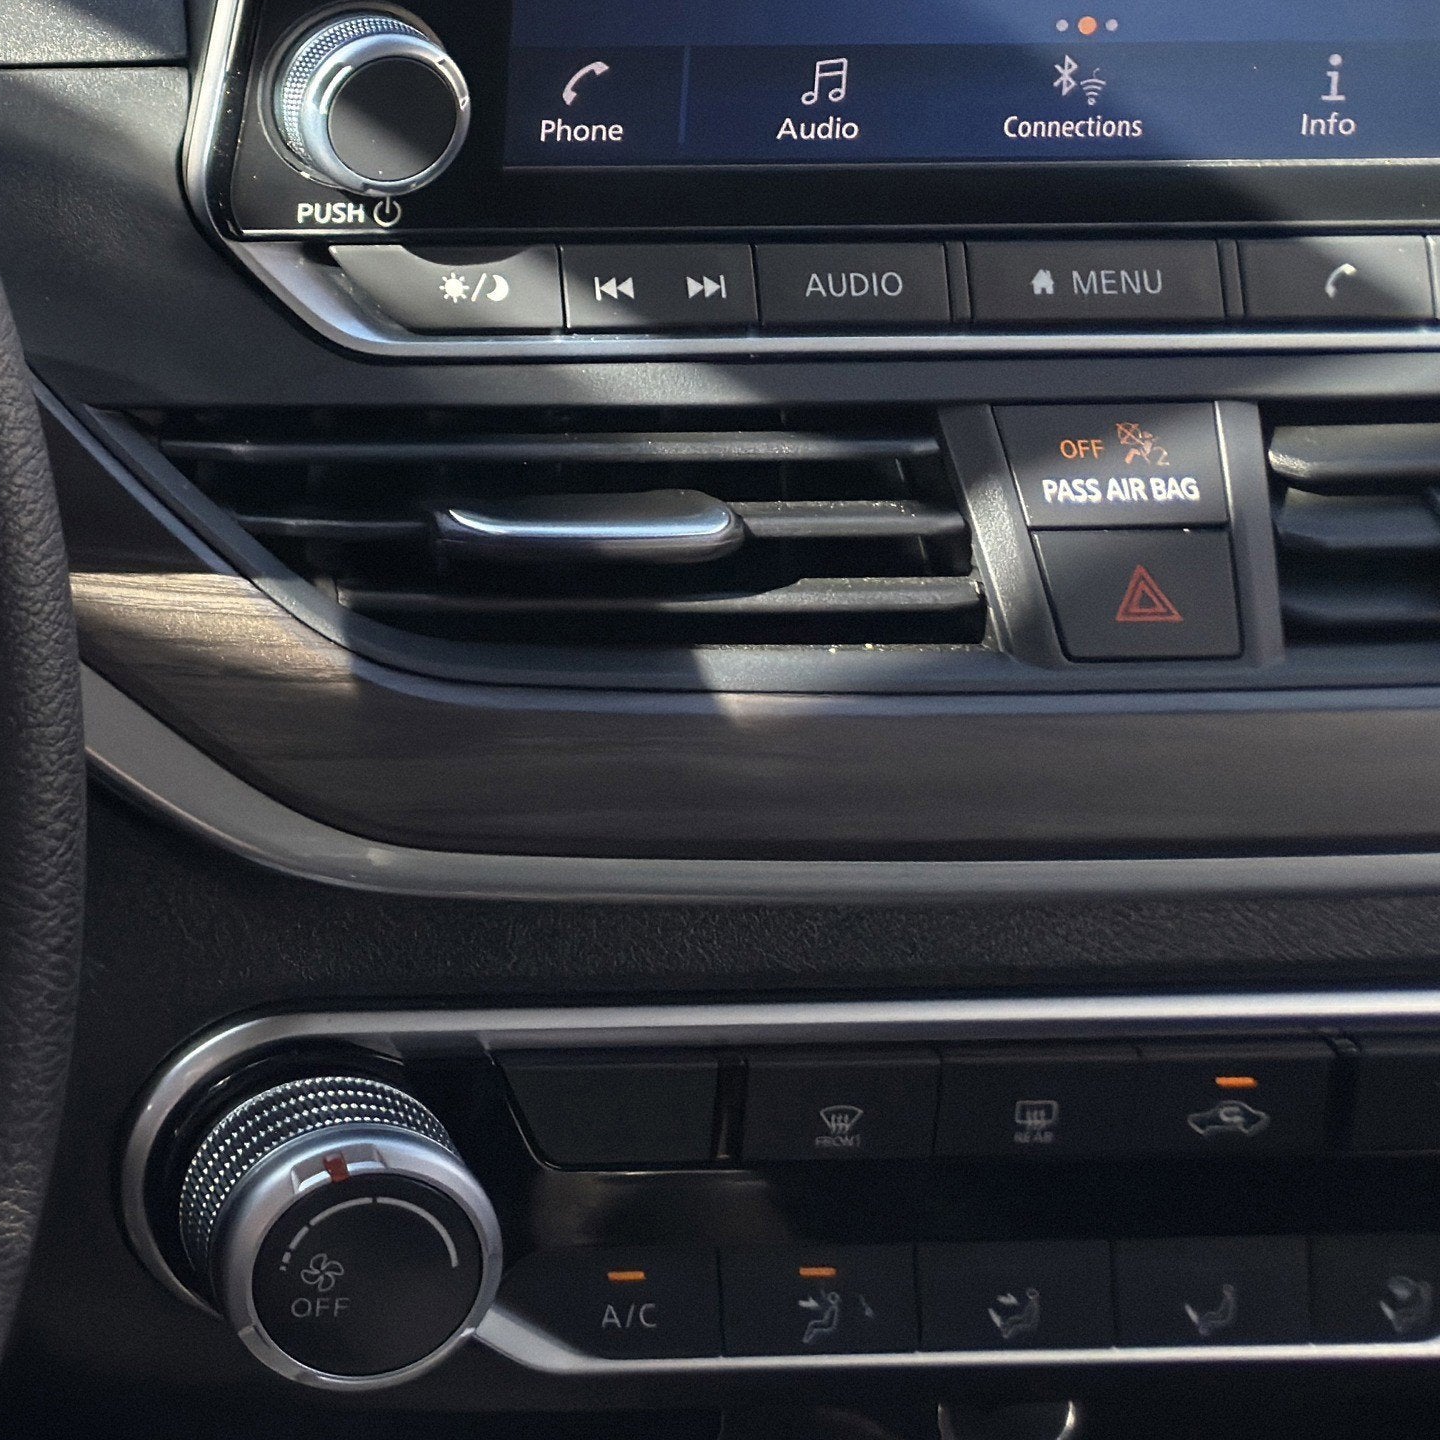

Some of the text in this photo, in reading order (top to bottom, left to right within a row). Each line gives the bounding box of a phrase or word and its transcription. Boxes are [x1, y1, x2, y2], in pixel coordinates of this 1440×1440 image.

[540, 119, 624, 142] Phone
[776, 116, 859, 142] Audio
[1003, 115, 1143, 138] Connections
[1300, 113, 1357, 137] Info
[297, 202, 365, 224] PUSH
[805, 271, 904, 299] AUDIO
[1072, 269, 1163, 295] MENU
[1060, 439, 1105, 460] OFF
[1042, 477, 1201, 503] PASS AIR BAG
[291, 1297, 350, 1318] OFF
[601, 1303, 657, 1329] A/C
